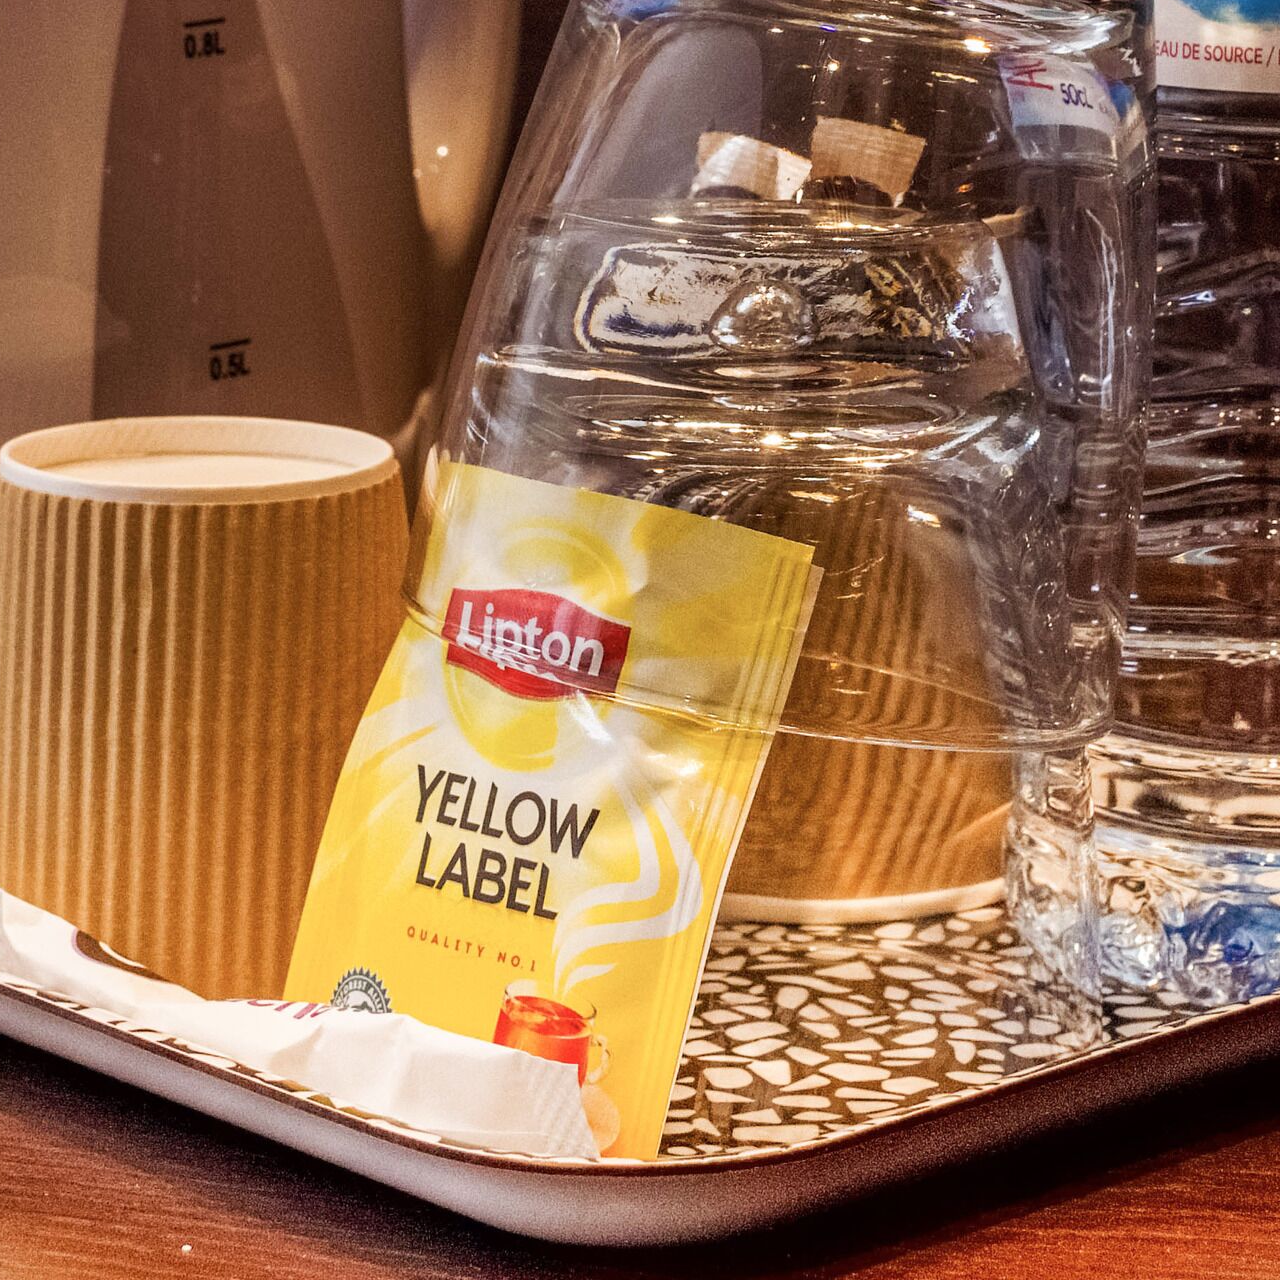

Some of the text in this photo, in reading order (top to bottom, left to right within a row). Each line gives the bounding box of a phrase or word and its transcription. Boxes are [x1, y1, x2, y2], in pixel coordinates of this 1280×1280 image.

[183, 30, 224, 59] 0.8L
[1154, 40, 1178, 58] EAU
[1182, 42, 1200, 60] DE
[1204, 44, 1263, 64] SOURCE
[209, 352, 250, 381] 0.5L
[456, 601, 604, 676] Lipton
[416, 764, 601, 859] YELLOW
[416, 831, 558, 920] LABEL
[407, 925, 485, 958] QUALITY
